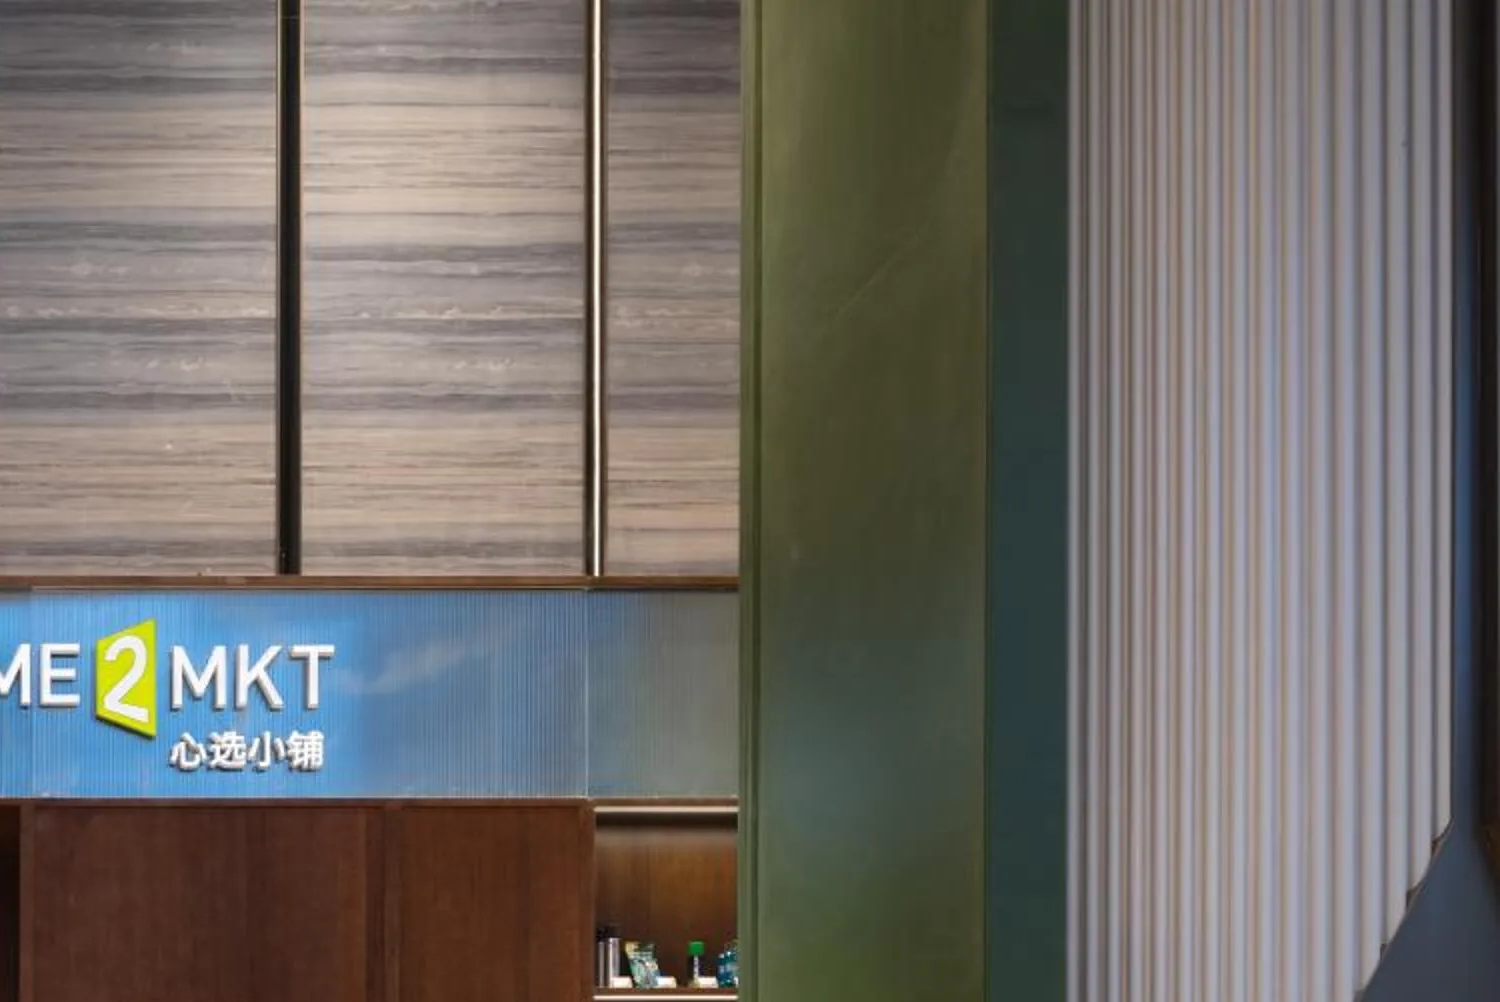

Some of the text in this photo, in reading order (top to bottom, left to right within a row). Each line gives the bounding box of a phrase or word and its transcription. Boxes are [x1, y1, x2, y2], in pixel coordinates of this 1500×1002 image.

[103, 635, 149, 723] 2
[170, 644, 336, 710] MKT
[170, 730, 325, 771] 心选小铺
